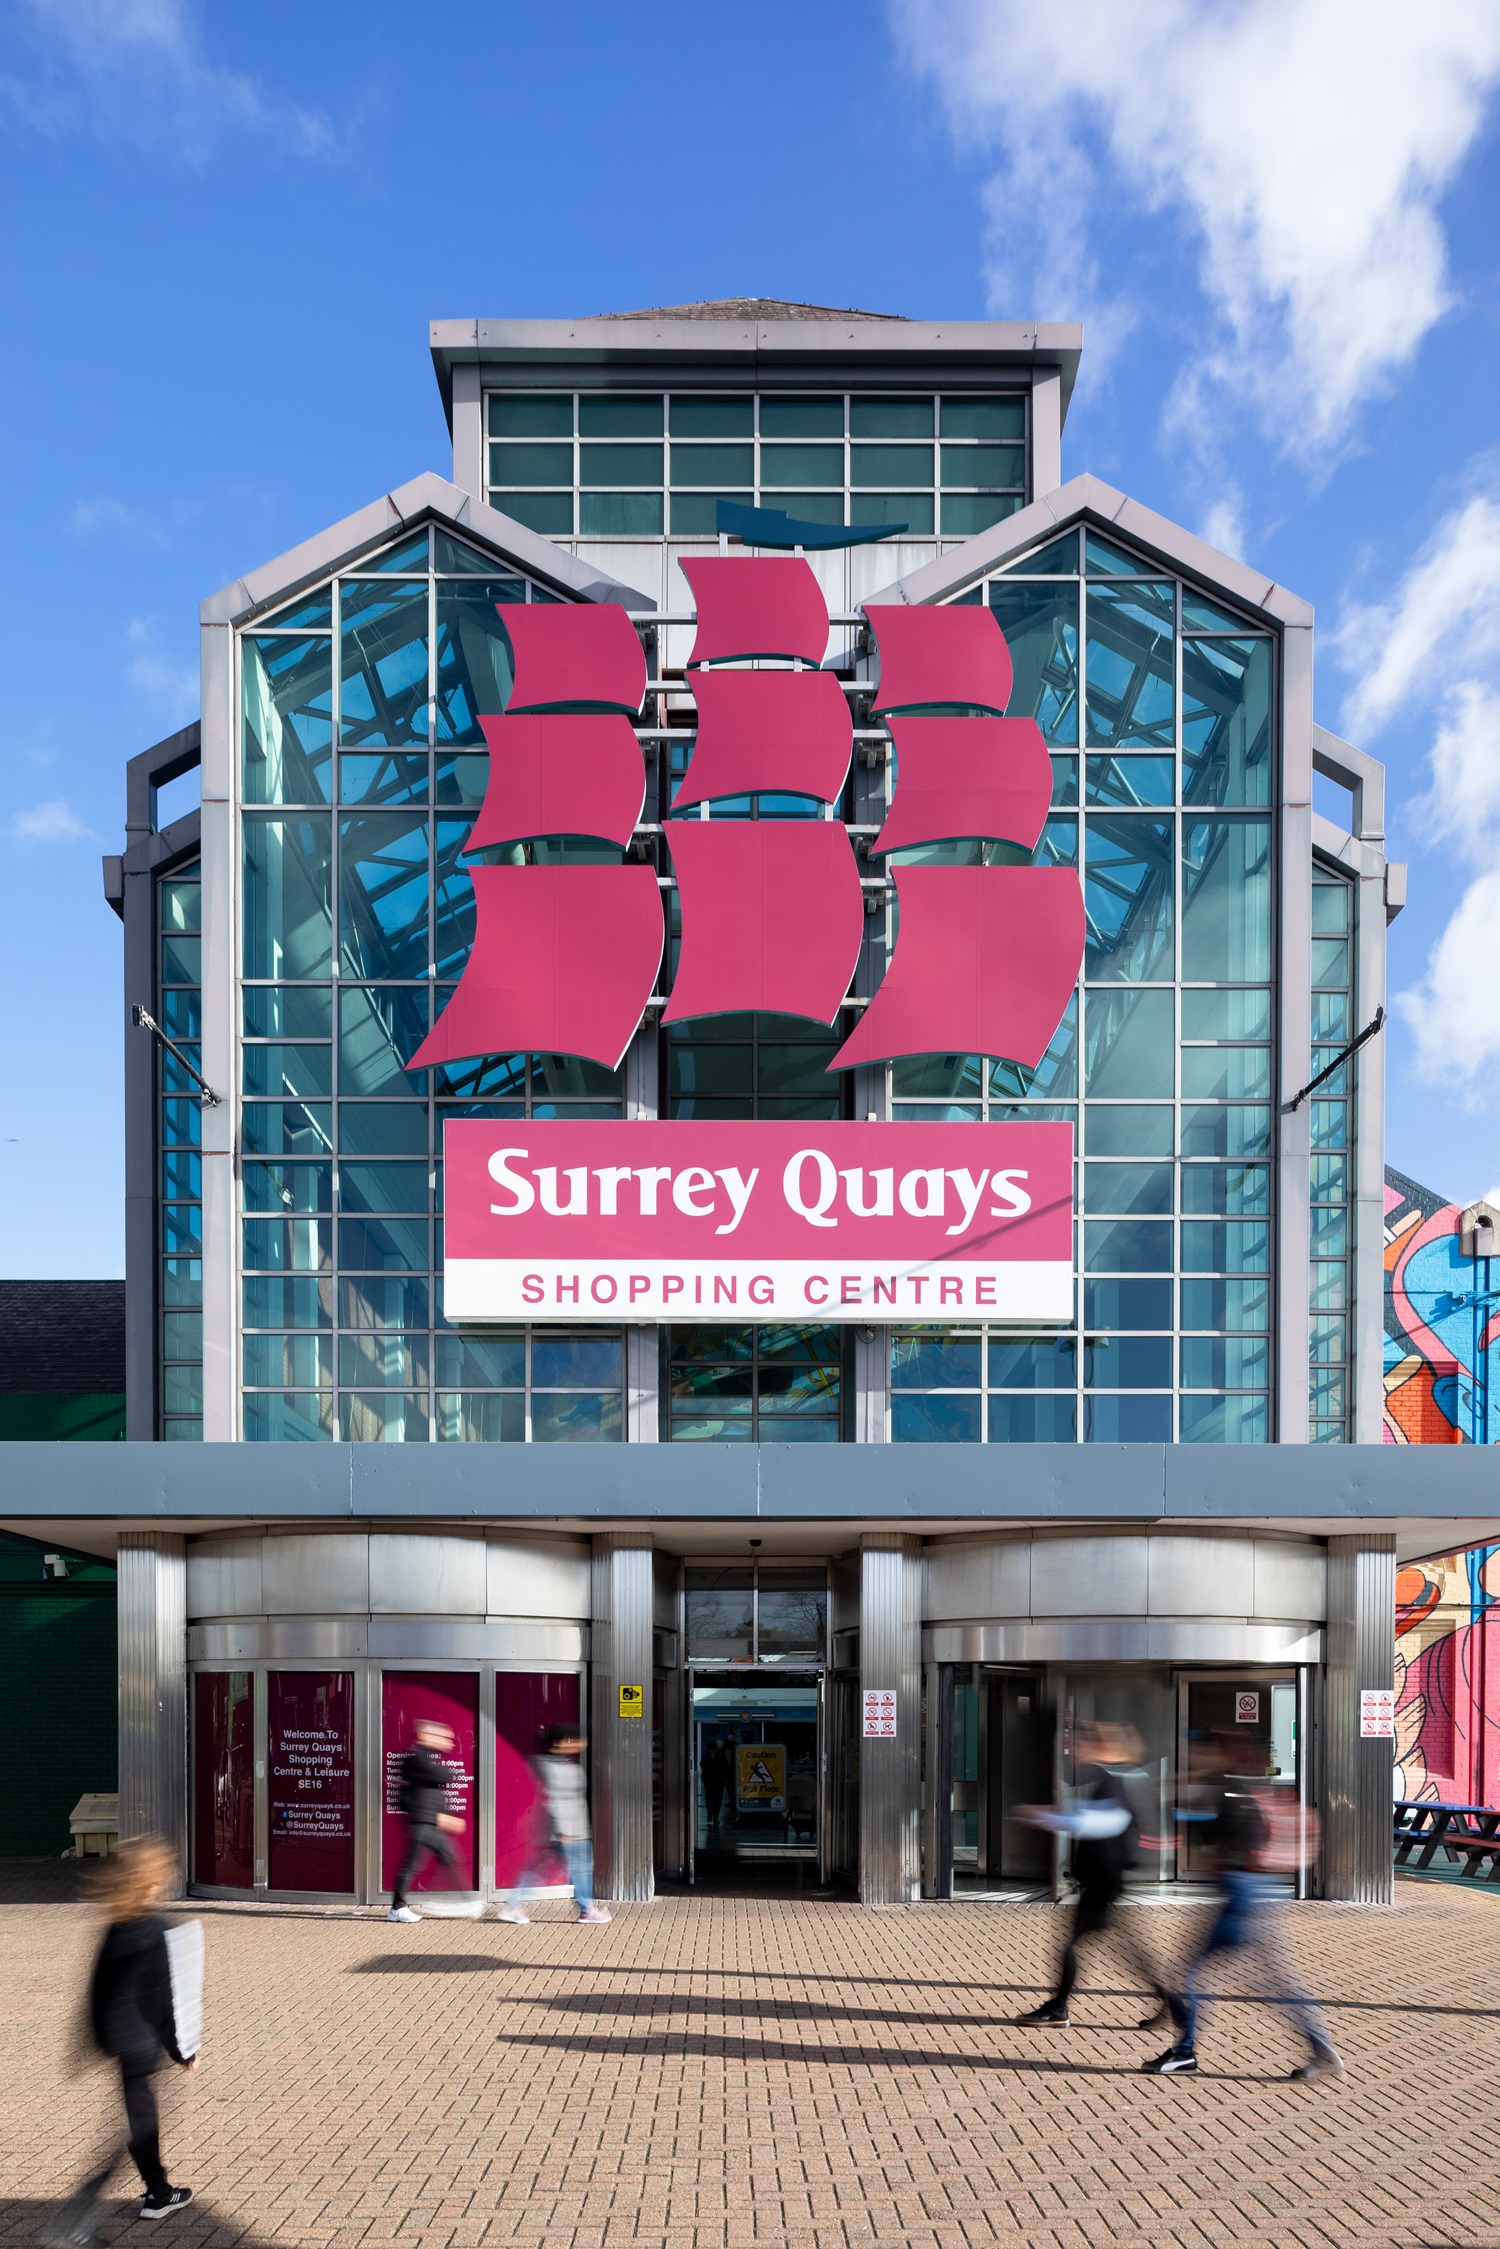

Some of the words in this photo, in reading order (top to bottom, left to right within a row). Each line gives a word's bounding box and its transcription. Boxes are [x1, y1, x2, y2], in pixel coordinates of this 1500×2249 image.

[488, 1148, 760, 1235] Surrey
[782, 1149, 1032, 1236] Quays
[521, 1274, 775, 1305] SHOPPING
[804, 1275, 998, 1306] CENTRE
[283, 1730, 324, 1739] Welcome
[326, 1730, 338, 1739] To
[280, 1742, 309, 1753] Surrey
[312, 1742, 342, 1754] Quays
[288, 1754, 332, 1766] Shopping
[274, 1766, 302, 1776] Centre
[305, 1768, 311, 1776] &
[314, 1768, 350, 1776] Leisure
[298, 1780, 322, 1788] SE16
[288, 1810, 313, 1820] Surrey
[315, 1811, 340, 1820] Quays
[286, 1821, 344, 1831] @SurreyQuays
